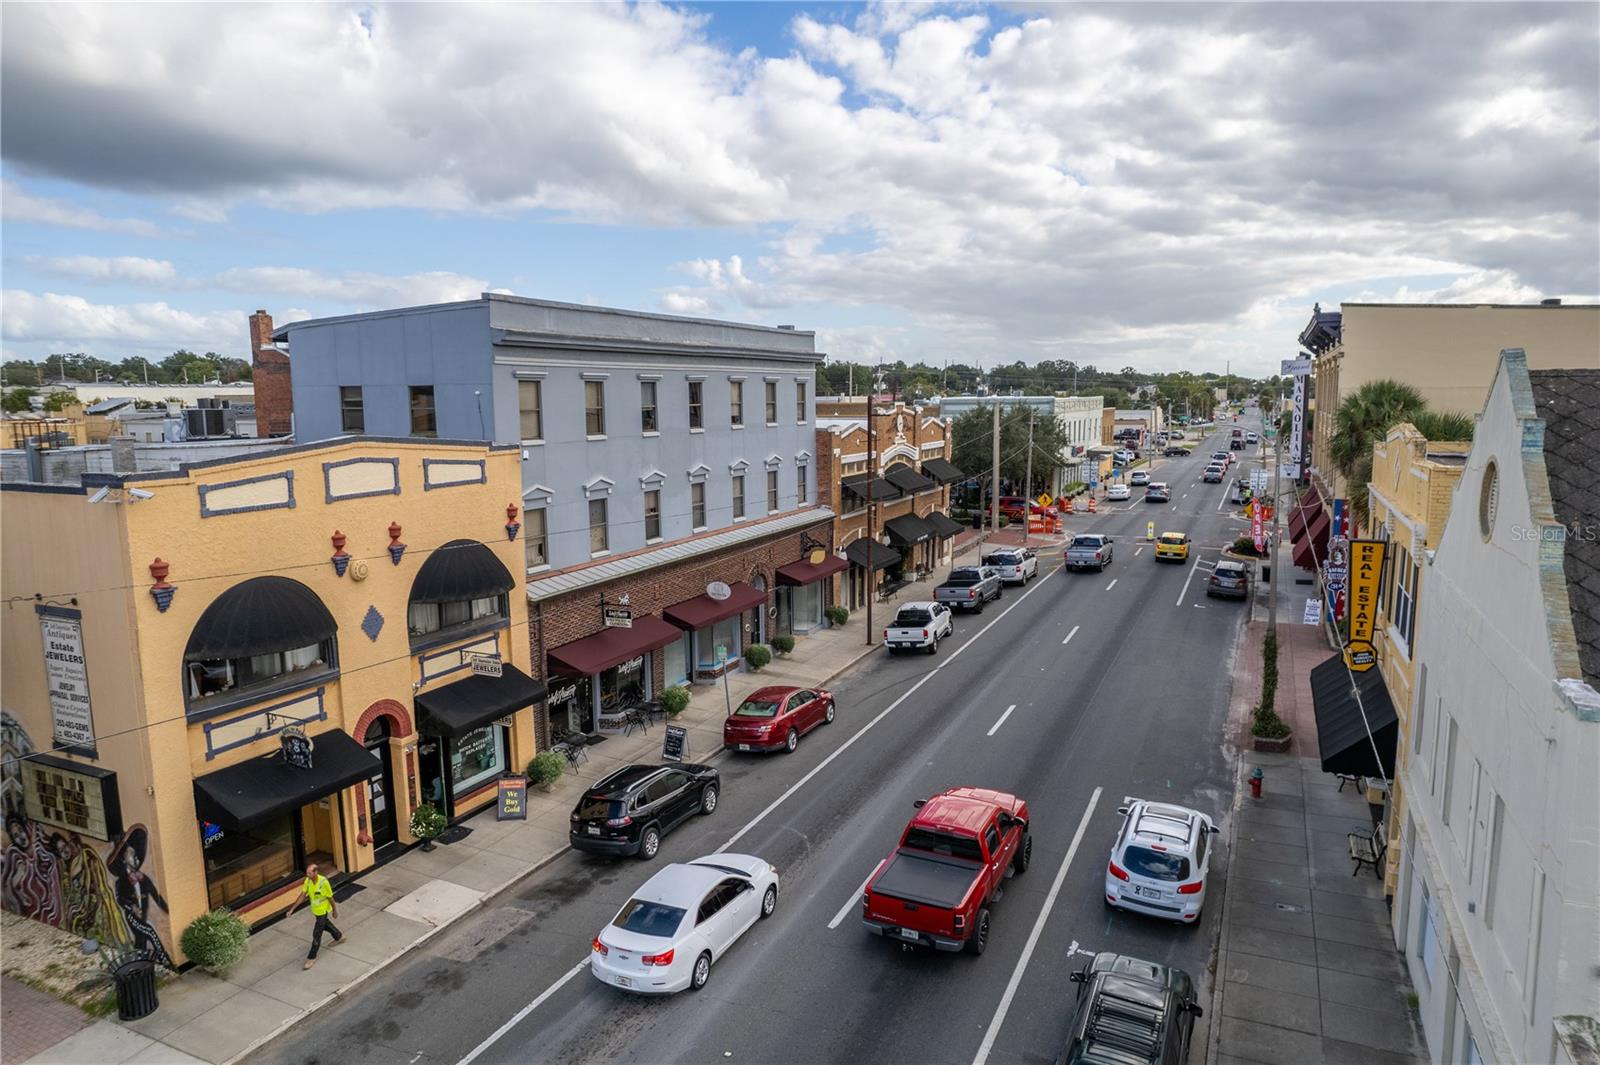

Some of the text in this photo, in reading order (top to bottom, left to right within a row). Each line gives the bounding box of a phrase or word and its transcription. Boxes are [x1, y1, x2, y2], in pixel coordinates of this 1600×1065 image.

[1293, 375, 1304, 452] MAGNOLIA
[1355, 545, 1375, 638] REAL ESTATE
[47, 629, 77, 640] Antiques
[50, 641, 75, 653] Estate
[45, 651, 84, 665] JEWELERS
[473, 663, 501, 673] JEWELERS
[505, 799, 518, 807] Buy
[503, 806, 520, 814] Gold
[204, 830, 224, 846] OPEN
